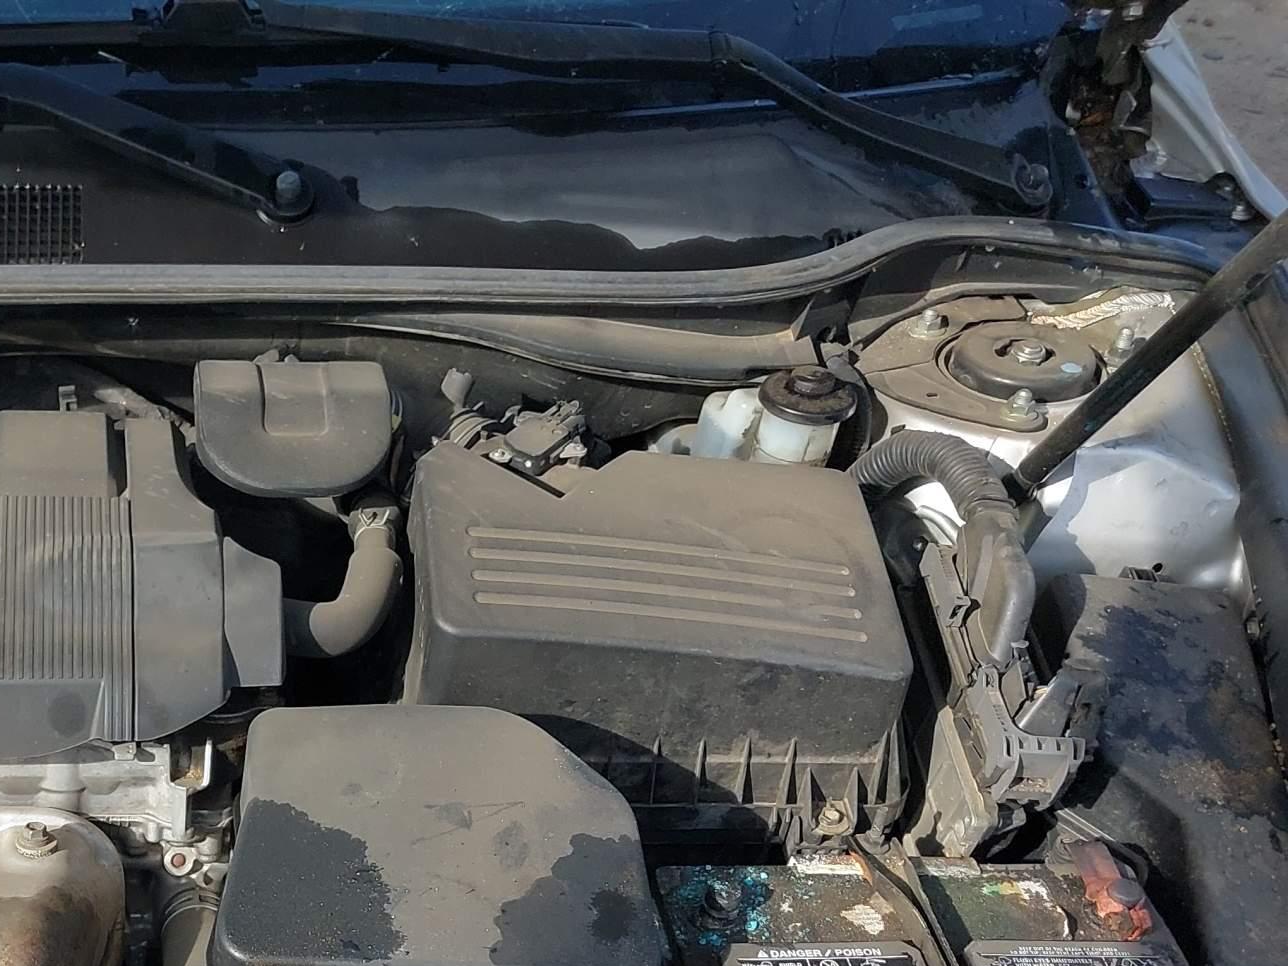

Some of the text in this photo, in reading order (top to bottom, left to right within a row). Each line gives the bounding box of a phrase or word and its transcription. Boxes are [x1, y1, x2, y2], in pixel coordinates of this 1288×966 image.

[769, 948, 882, 958] DANGER / POISON
